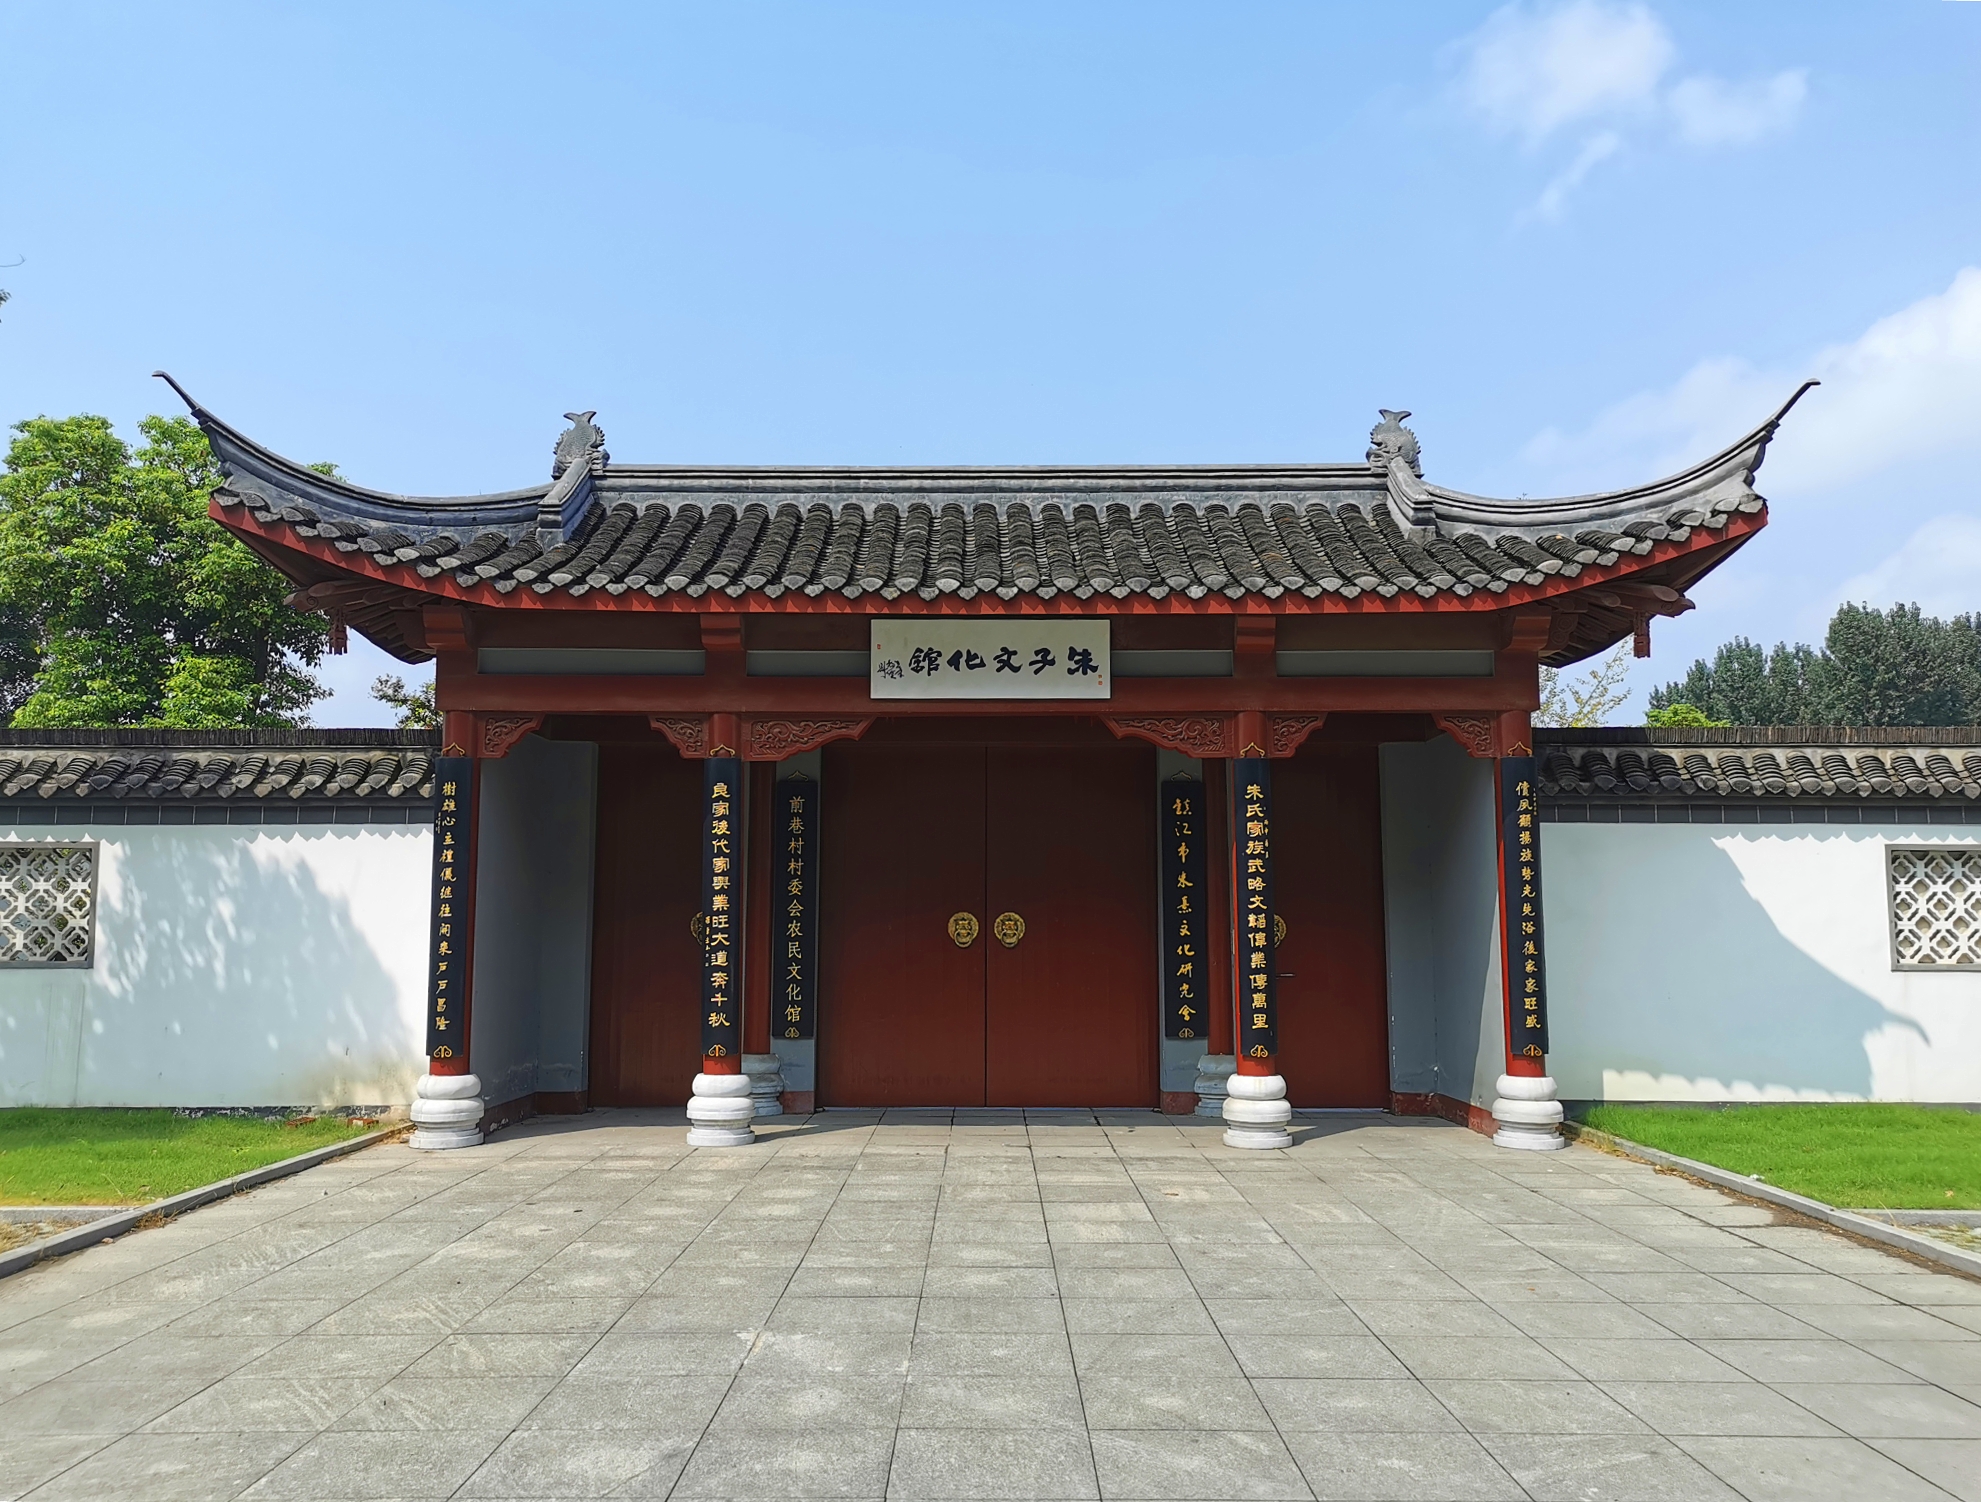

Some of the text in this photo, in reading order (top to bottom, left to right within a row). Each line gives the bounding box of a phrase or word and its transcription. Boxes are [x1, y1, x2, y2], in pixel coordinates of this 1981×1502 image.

[785, 795, 806, 1023] 前巷村村委会农民文化馆
